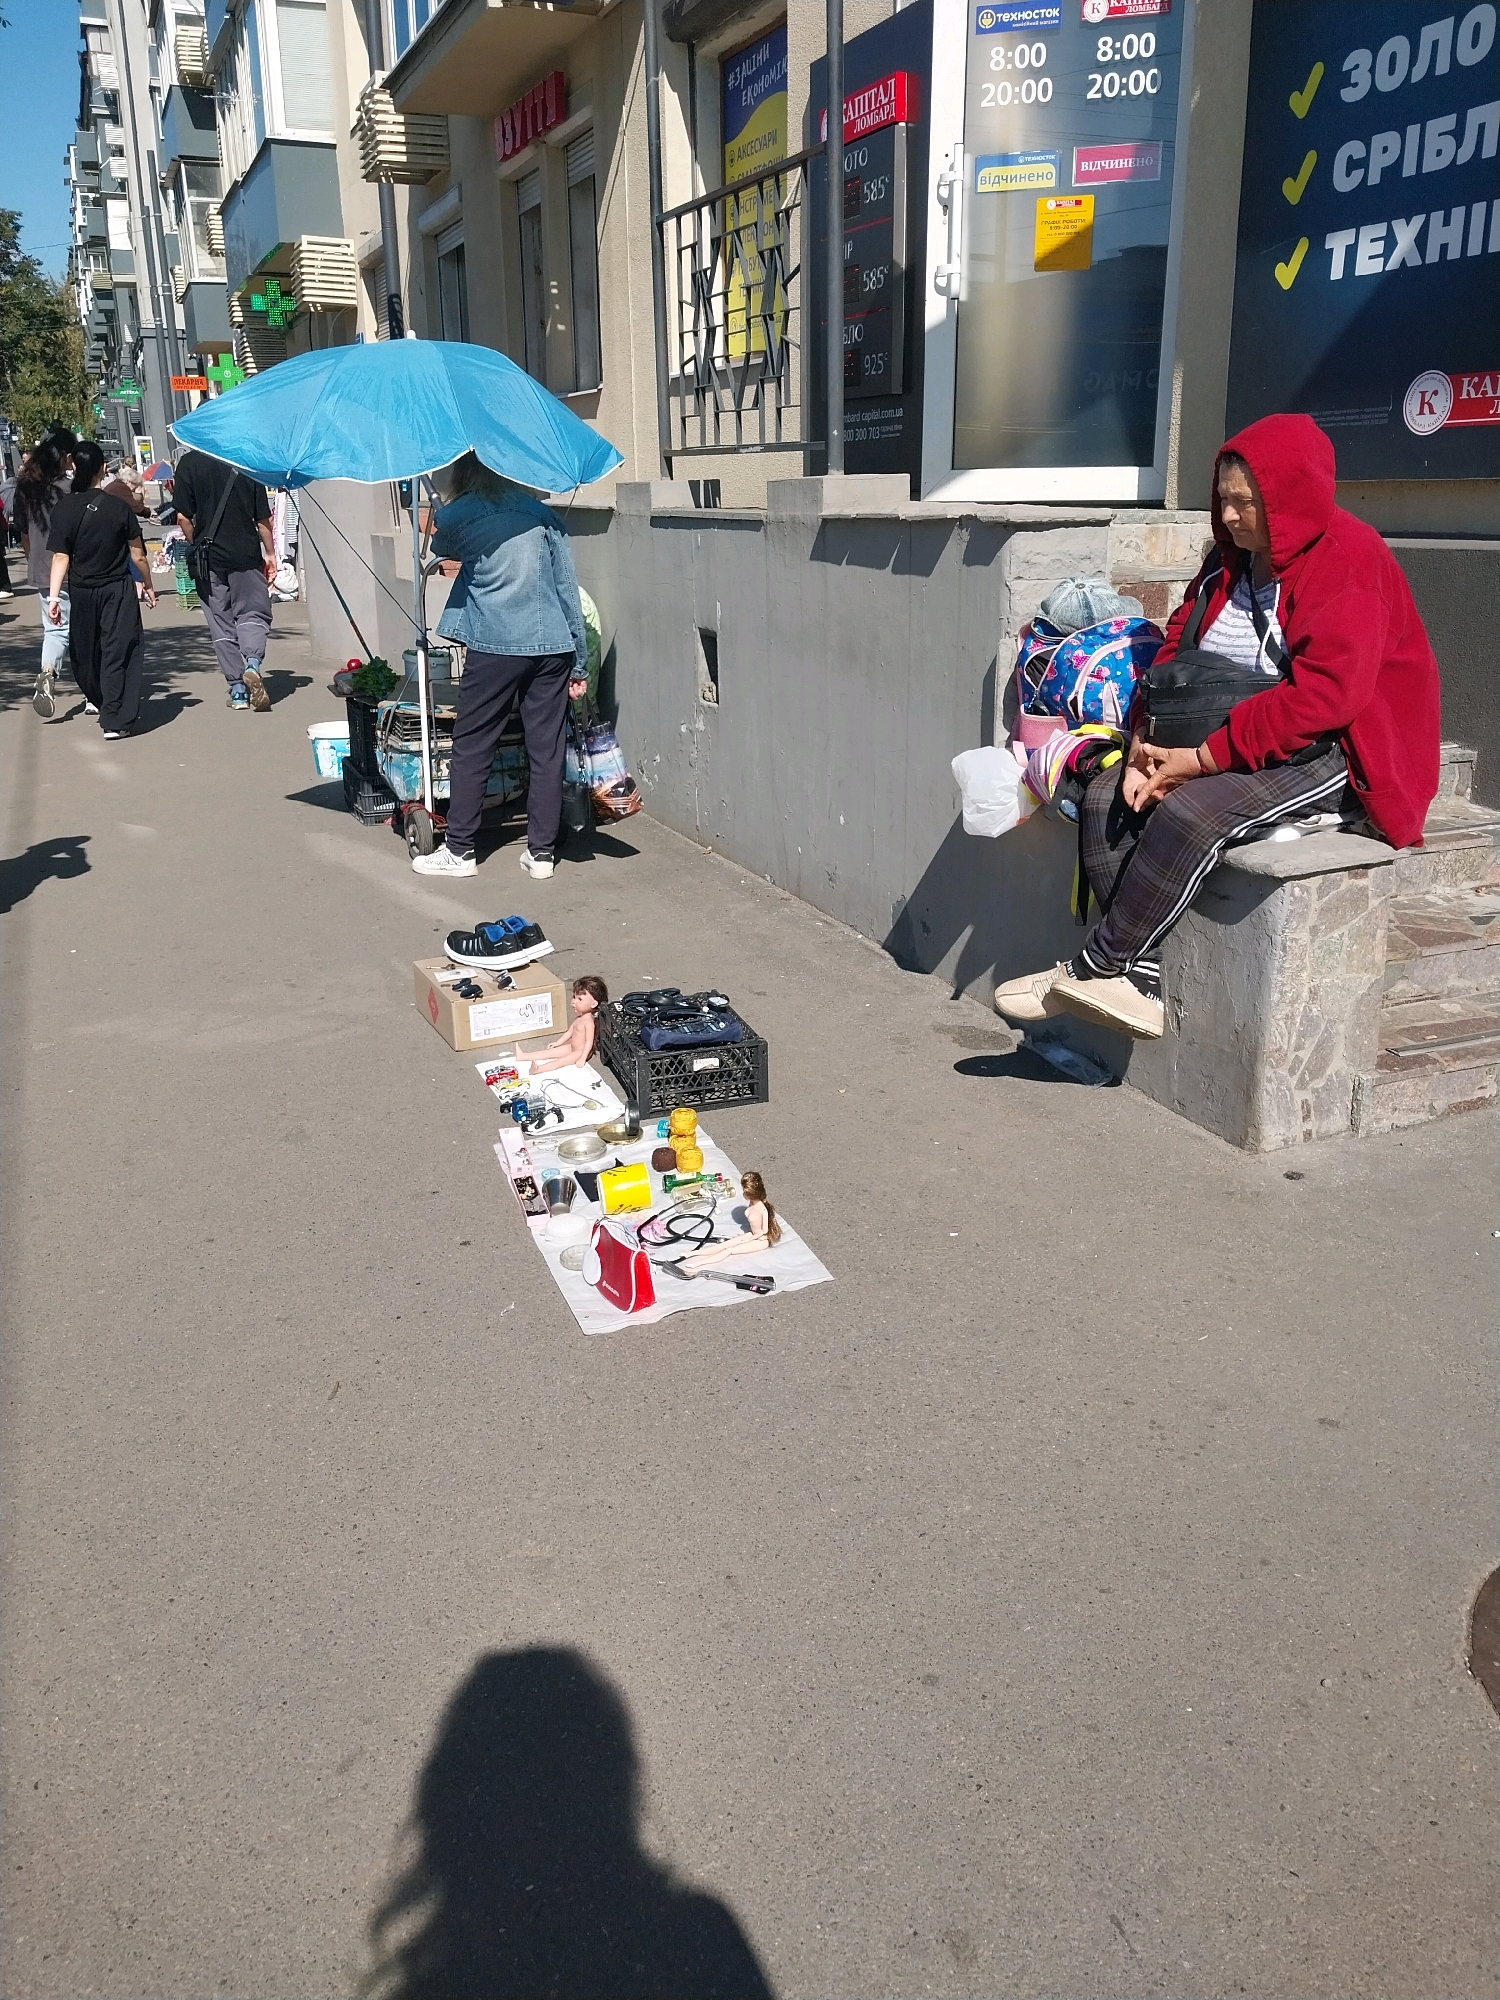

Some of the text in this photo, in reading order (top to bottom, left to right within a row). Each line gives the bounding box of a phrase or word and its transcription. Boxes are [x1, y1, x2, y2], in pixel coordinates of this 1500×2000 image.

[1125, 2, 1168, 13] ЛОМБАРД
[989, 42, 1047, 71] 8:00
[1096, 32, 1156, 62] 8:00
[980, 77, 1053, 107] 20:00
[1086, 68, 1162, 100] 20:00
[854, 102, 895, 133] ЛОМБАРД
[737, 128, 778, 163] АКСЕСУАРИ
[1080, 156, 1154, 172] ВІДЧИНЕНО
[980, 170, 1054, 188] відчинено
[1459, 375, 1500, 399] КА
[868, 426, 880, 440] 703
